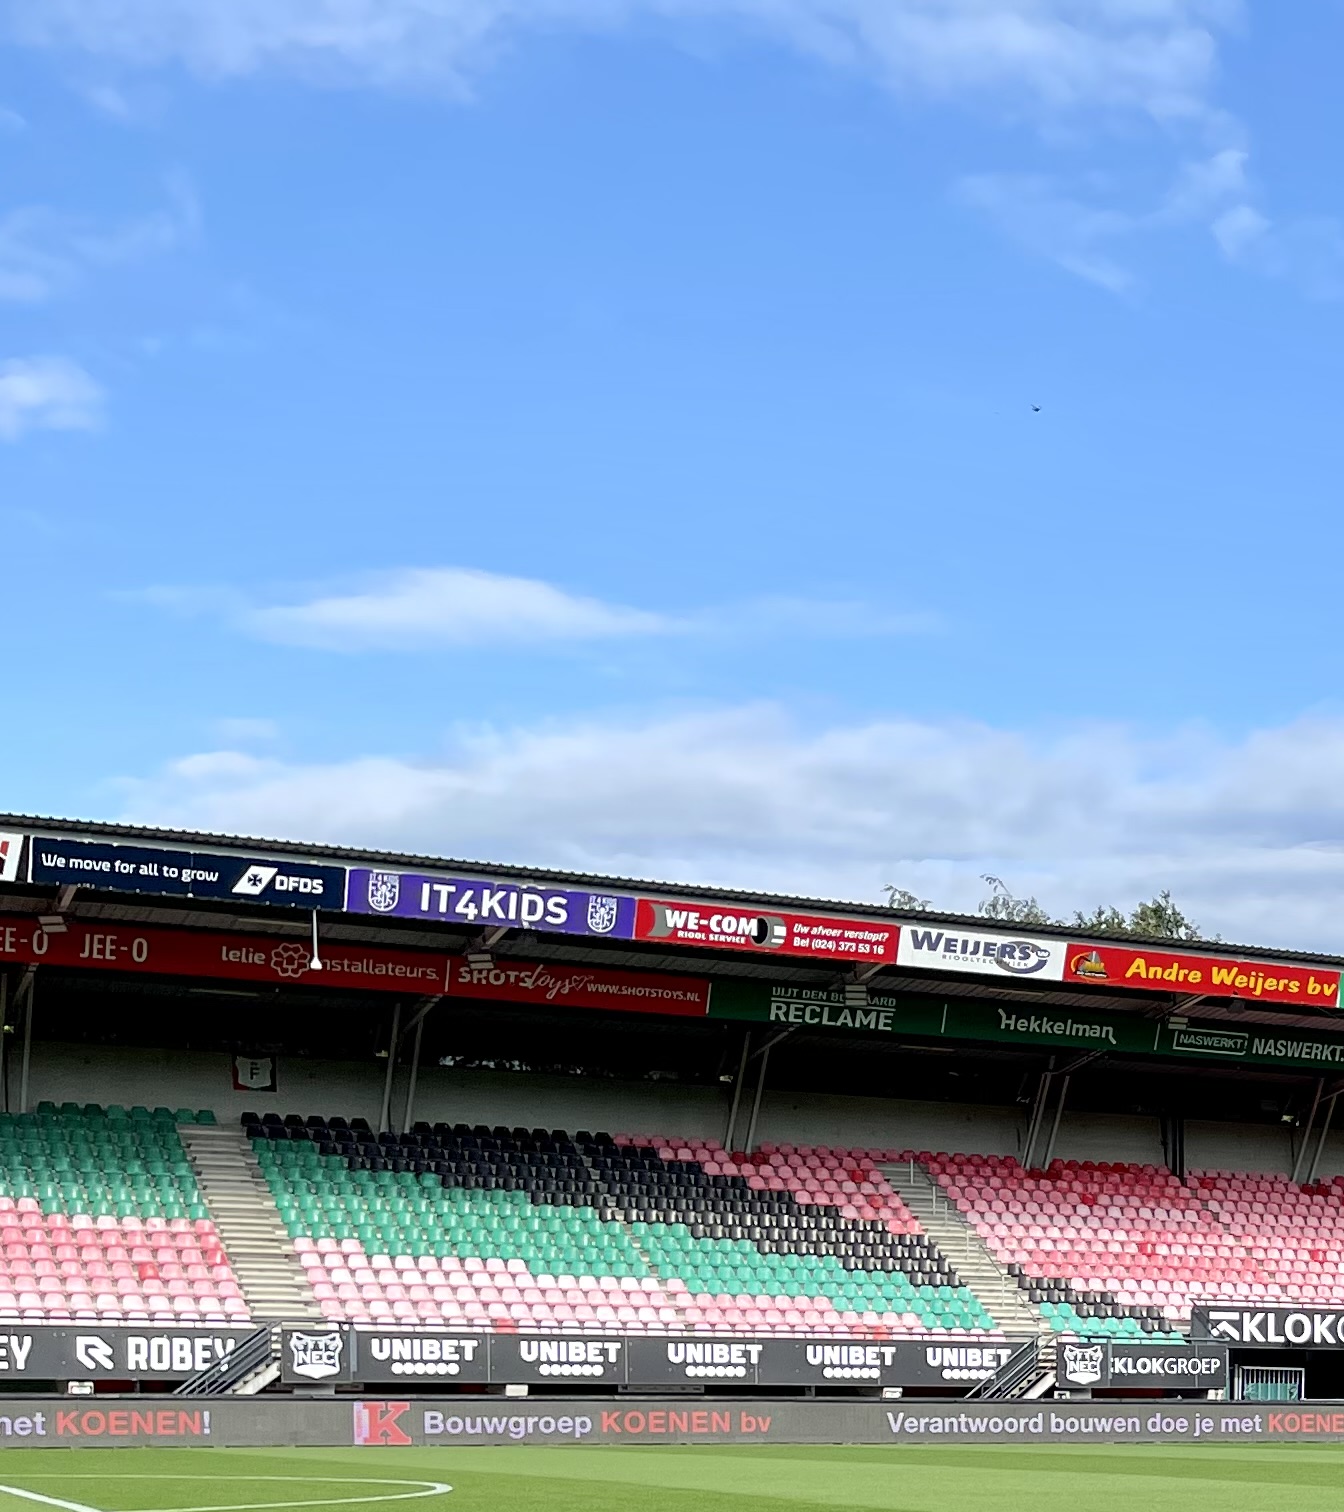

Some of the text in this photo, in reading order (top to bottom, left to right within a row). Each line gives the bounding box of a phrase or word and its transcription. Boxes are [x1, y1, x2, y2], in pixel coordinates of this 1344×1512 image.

[41, 852, 220, 884] We move for all to grow
[275, 874, 323, 895] DFDS
[420, 881, 569, 926] IT4KIDS
[665, 908, 758, 937] WE-COM
[793, 922, 890, 942] Uw afvoer verstopt?
[79, 932, 149, 963] JEE-O
[677, 929, 747, 945] RIOOL SERVICE
[793, 936, 885, 955] Bel (024) 373 53 16
[910, 929, 1032, 961] WEIJERS
[221, 945, 440, 982] lelie nstallateurs.
[1125, 957, 1337, 998] Andre Weijers bv
[772, 986, 828, 1001] UIJT DEN
[769, 1001, 894, 1032] RECLAME
[997, 1007, 1117, 1044] Hekkelman
[127, 1335, 236, 1372] ROBEY
[299, 1351, 337, 1365] NEC
[371, 1337, 479, 1362] UNIBET
[520, 1340, 621, 1364] UNIBET
[667, 1342, 763, 1365] UNIBET
[806, 1344, 897, 1366] UNIBET
[926, 1347, 1012, 1367] UNIBET
[1114, 1357, 1221, 1375] KLOKGROEP
[55, 1410, 211, 1436] KOENEN!
[423, 1410, 772, 1439] Bouwgroep KOENEN bv
[887, 1412, 1044, 1434] Verantwoord
[1050, 1412, 1140, 1434] bouwen
[1146, 1412, 1189, 1434] doe
[1193, 1412, 1215, 1438] je
[1220, 1414, 1263, 1434] met
